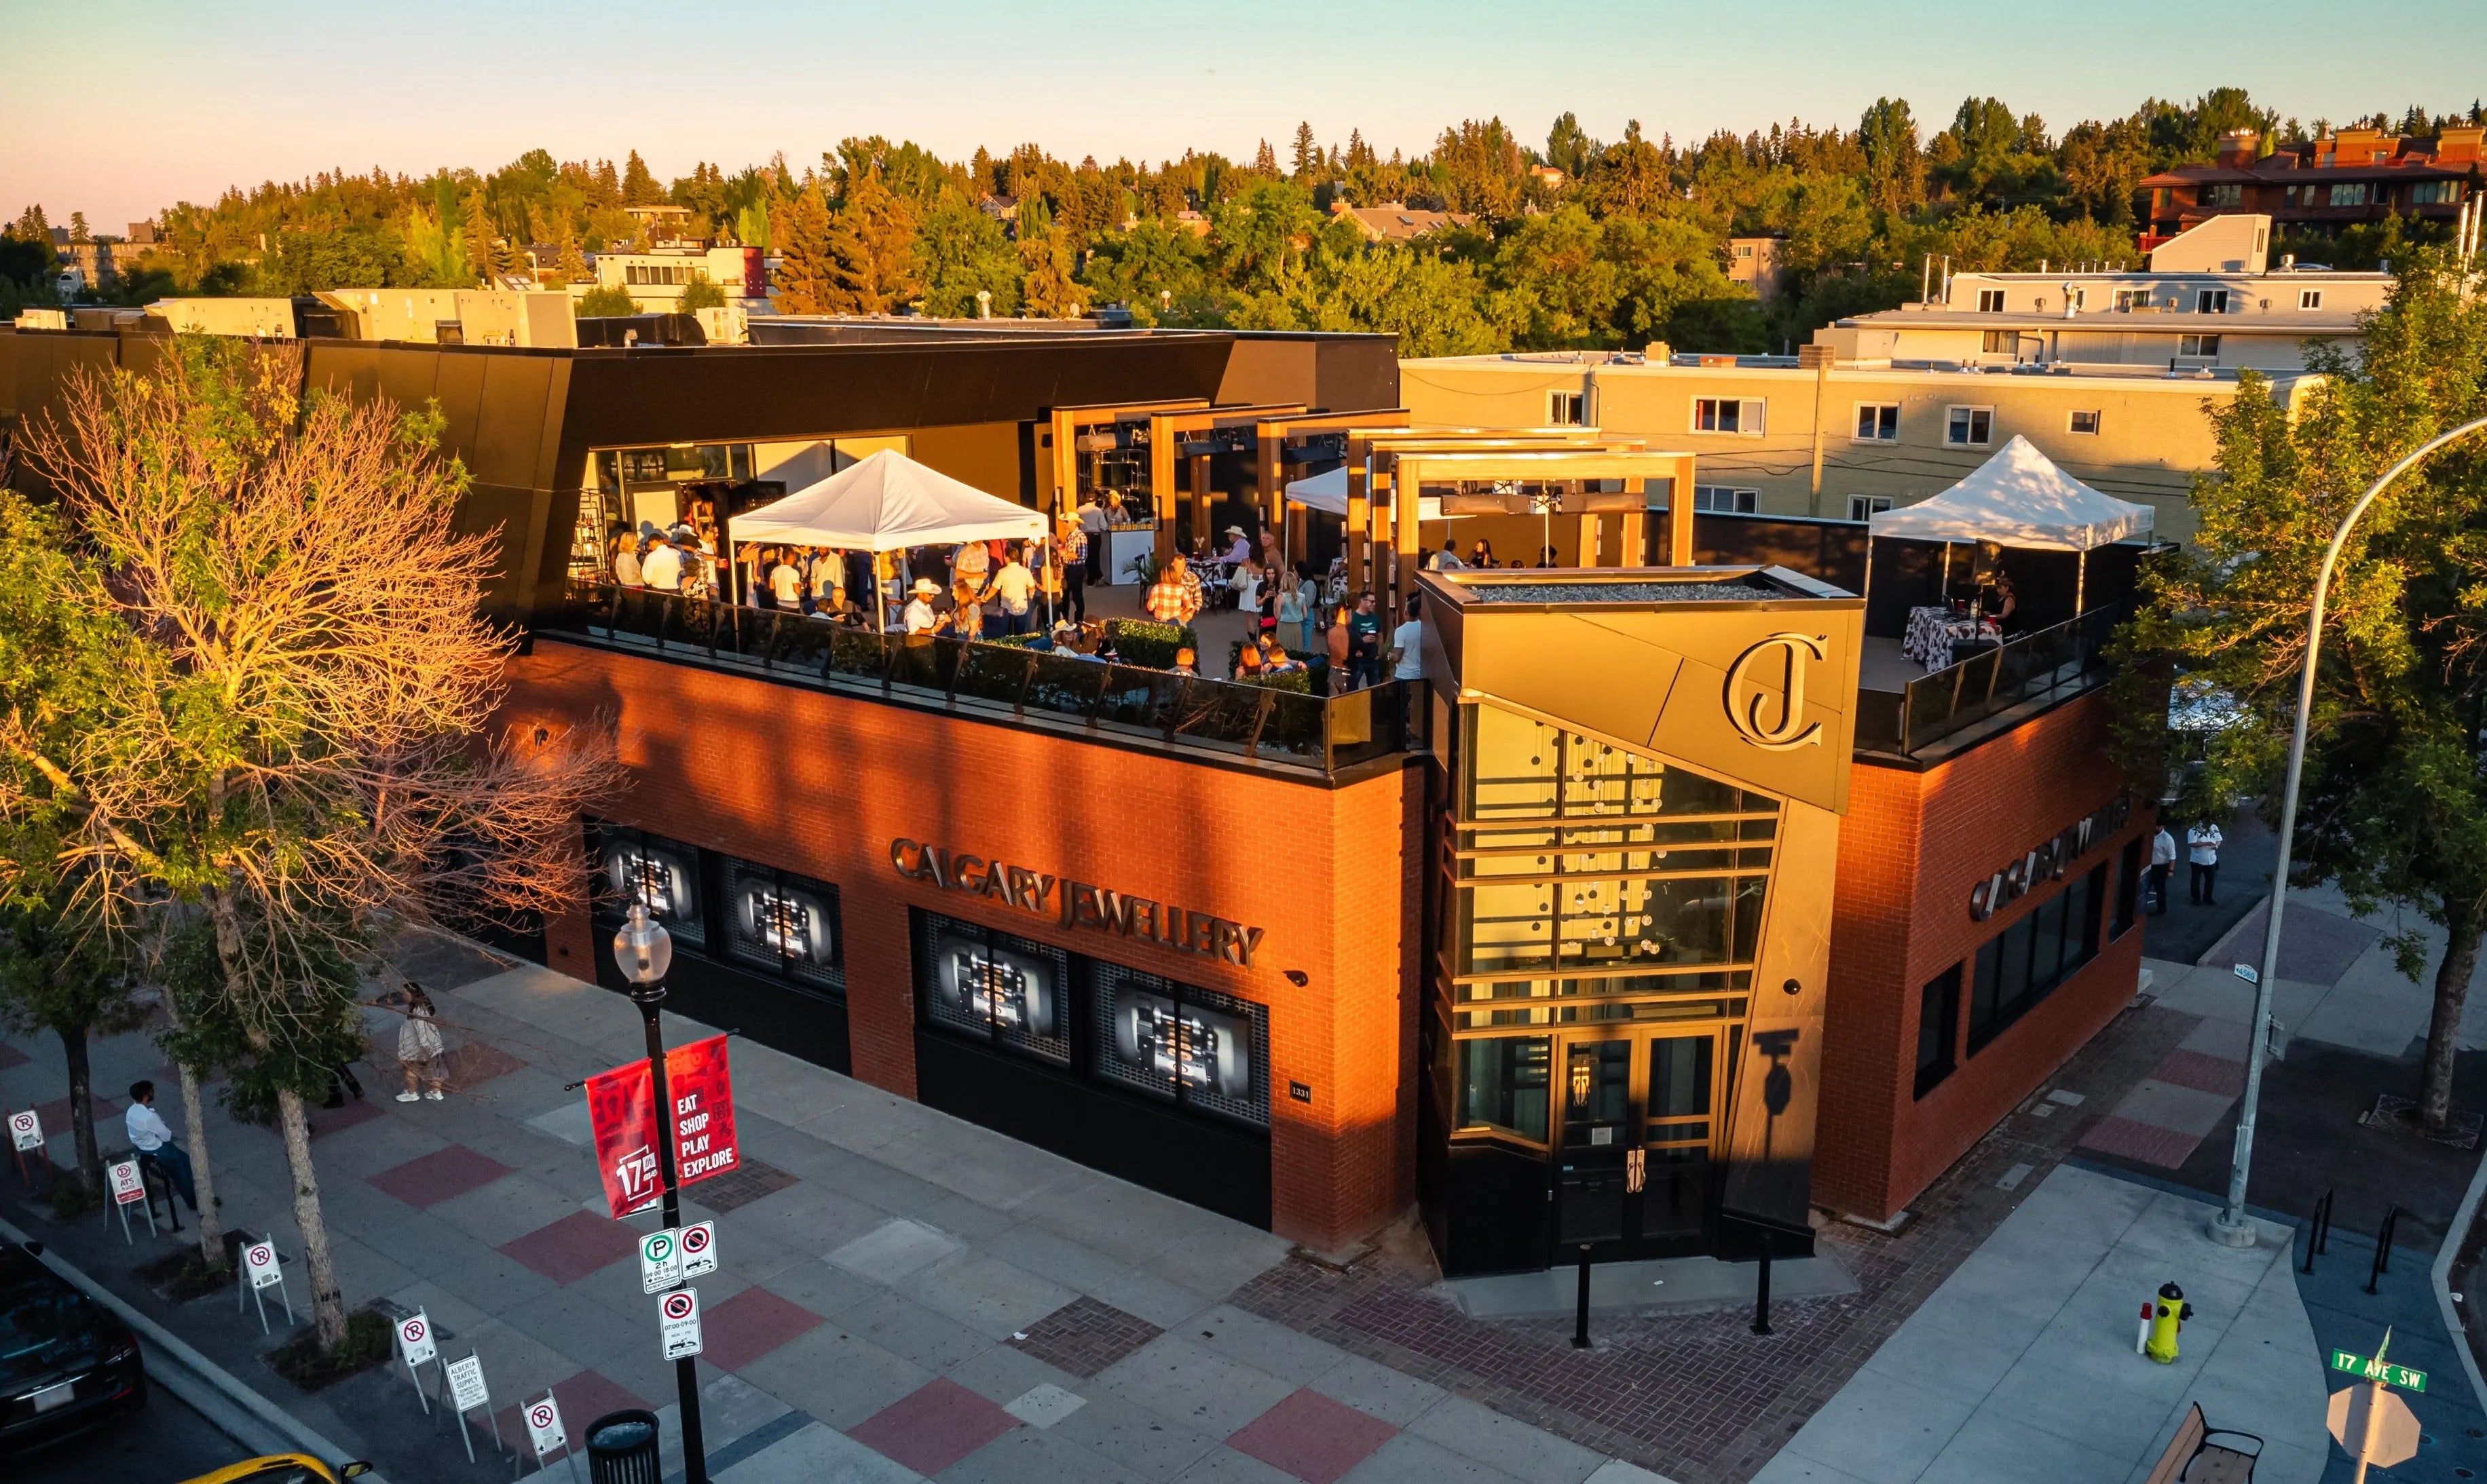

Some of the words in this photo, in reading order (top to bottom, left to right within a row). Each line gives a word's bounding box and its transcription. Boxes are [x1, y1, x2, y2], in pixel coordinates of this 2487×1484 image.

[891, 838, 1055, 914] CALGARY
[1057, 877, 1265, 970] JEWELLERY
[677, 1094, 696, 1115] EAT
[679, 1113, 709, 1136] SHOP
[681, 1134, 709, 1158] PLAY
[684, 1147, 734, 1178] EXPLORE
[120, 1177, 134, 1187] ATS
[451, 1361, 476, 1375] ALBERTA
[453, 1368, 477, 1382] TRAFFIC
[2338, 1353, 2357, 1370] 17
[2365, 1360, 2391, 1380] AVE
[2399, 1370, 2420, 1388] SW
[456, 1375, 478, 1389] SUPPLY
